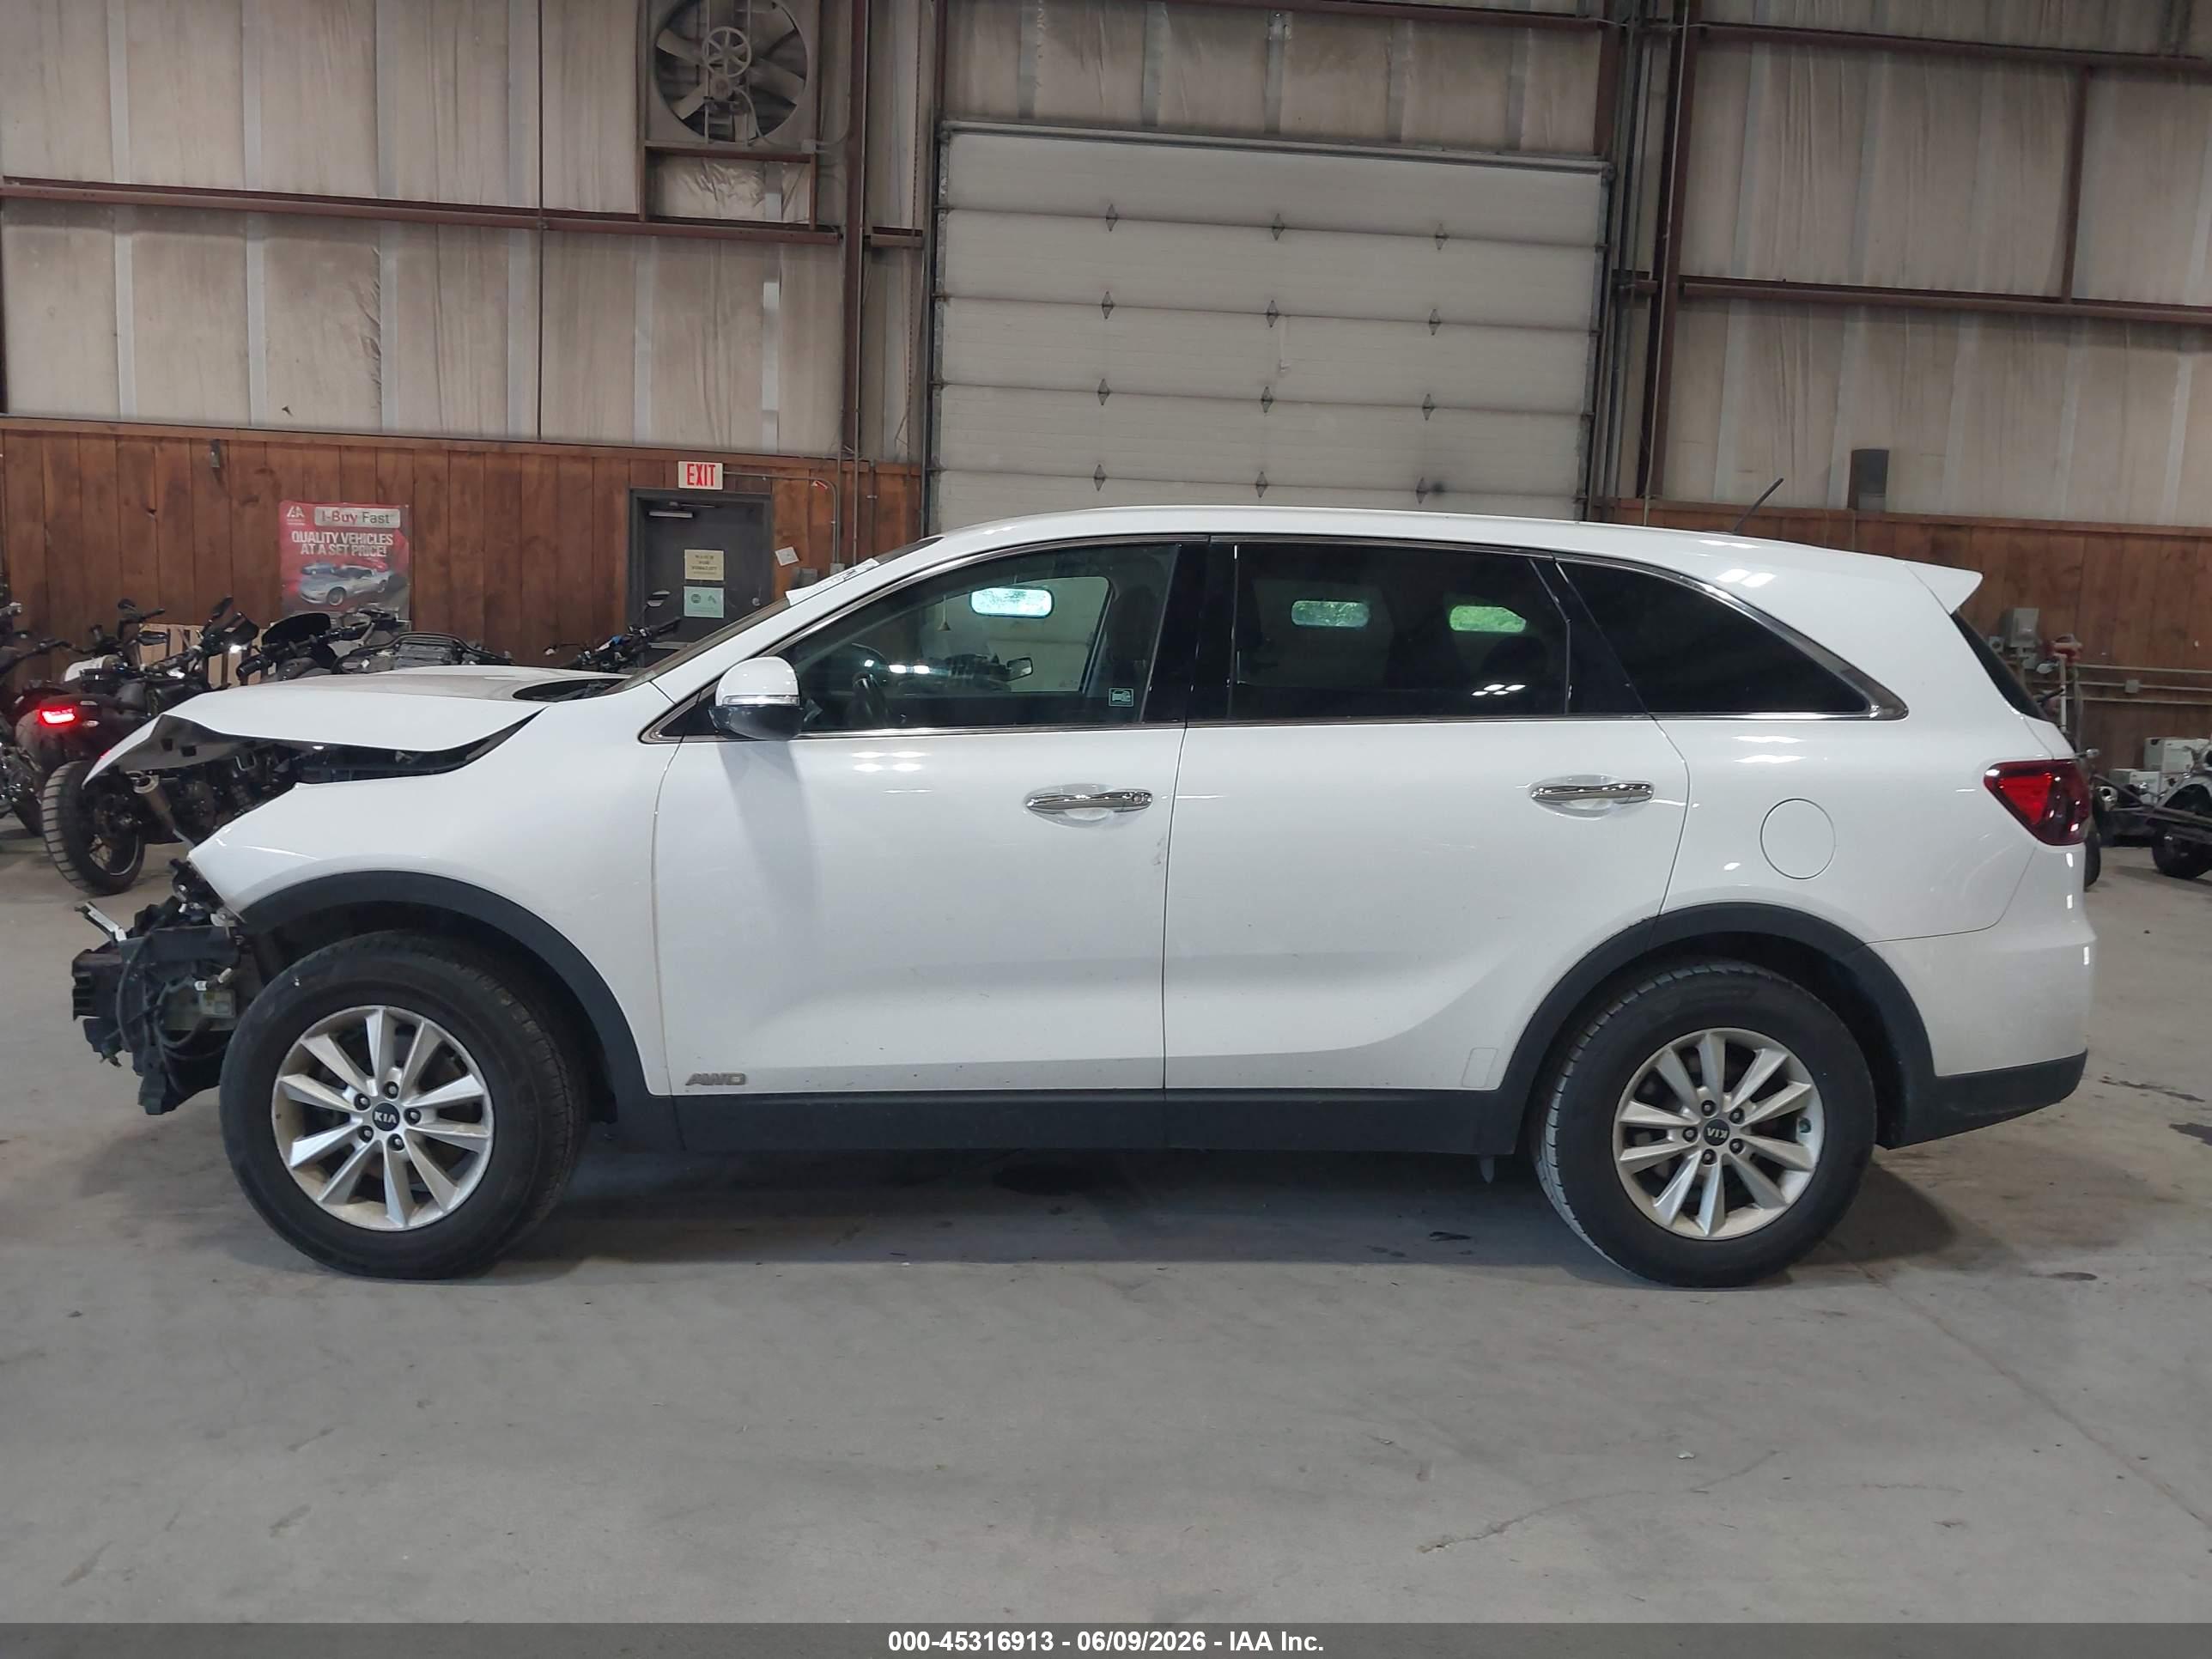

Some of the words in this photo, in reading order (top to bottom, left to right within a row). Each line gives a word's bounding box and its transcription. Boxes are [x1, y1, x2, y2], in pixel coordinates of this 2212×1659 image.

[687, 463, 716, 487] EXIT
[322, 510, 357, 525] I-Buy
[362, 512, 390, 524] Fast
[291, 531, 339, 544] QUALITY
[341, 532, 393, 545] VEHICLES
[301, 543, 316, 555] AT
[317, 544, 326, 555] A
[328, 544, 349, 556] SET
[351, 545, 387, 556] PRICE!
[685, 1073, 746, 1085] AWD
[374, 1111, 397, 1123] KIA
[1707, 1127, 1729, 1139] KIA
